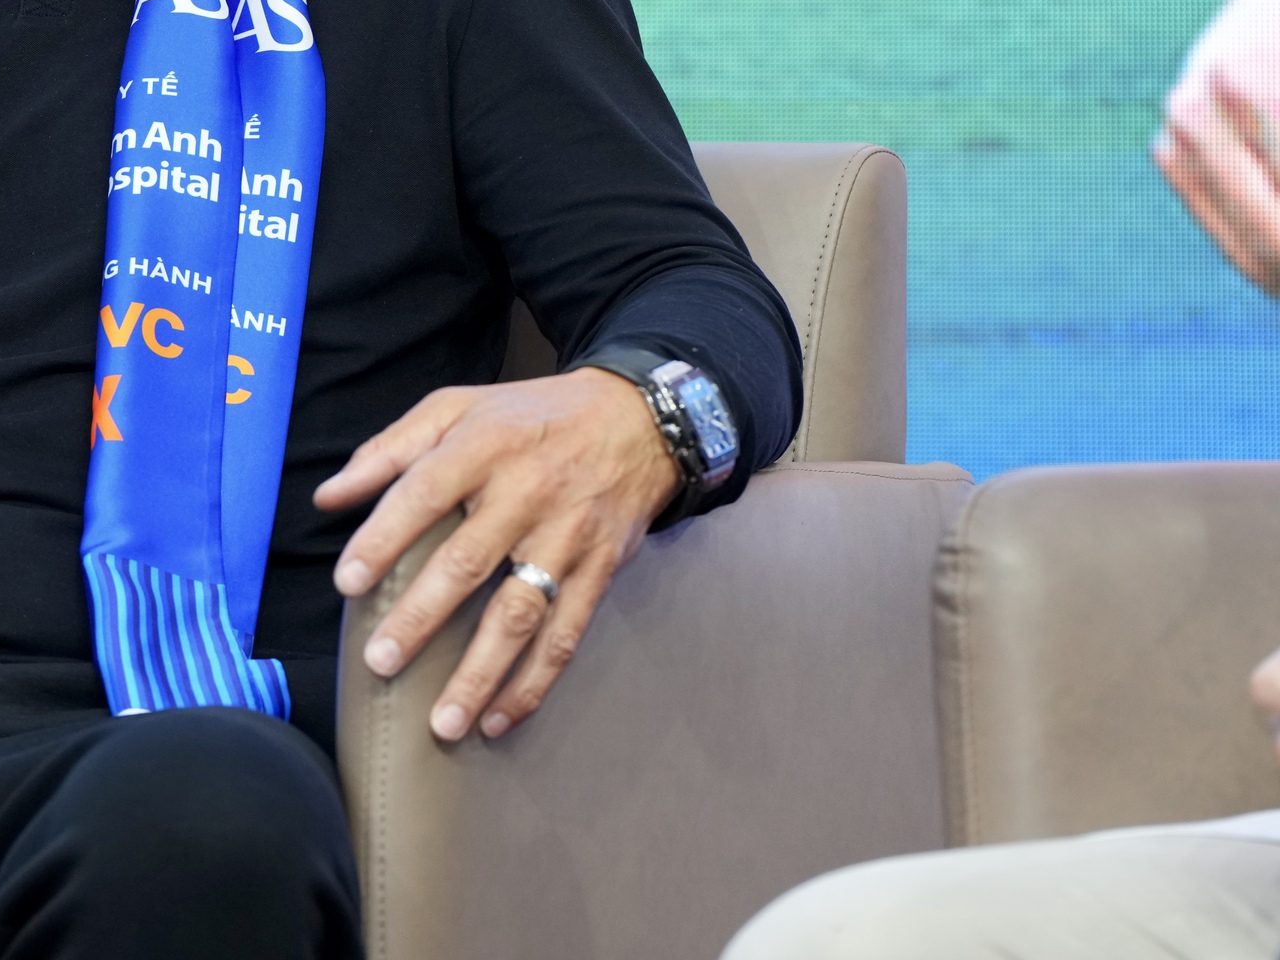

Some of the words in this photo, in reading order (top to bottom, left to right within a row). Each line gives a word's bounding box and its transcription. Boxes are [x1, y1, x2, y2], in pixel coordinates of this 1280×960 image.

[141, 71, 179, 97] TẾ
[141, 121, 223, 163] Anh
[128, 256, 213, 295] HÀNH
